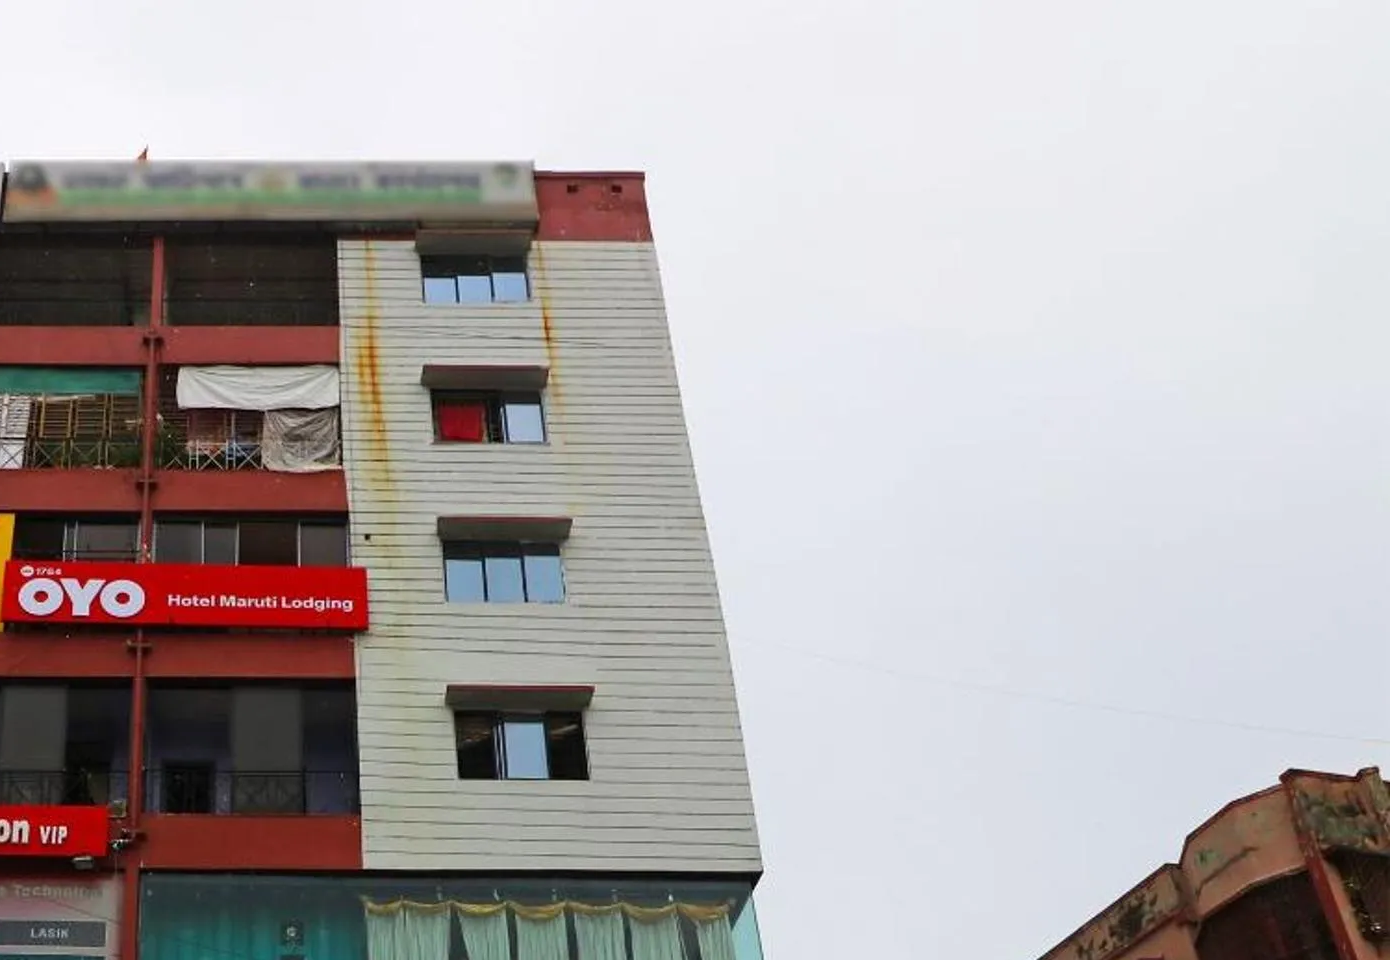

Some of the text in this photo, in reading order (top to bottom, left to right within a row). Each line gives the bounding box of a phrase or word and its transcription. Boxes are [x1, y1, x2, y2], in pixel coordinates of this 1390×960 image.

[17, 578, 146, 617] OYO
[168, 594, 354, 612] Hotel Maruti Lodging
[39, 825, 68, 845] VIP
[30, 926, 70, 939] LASIK
